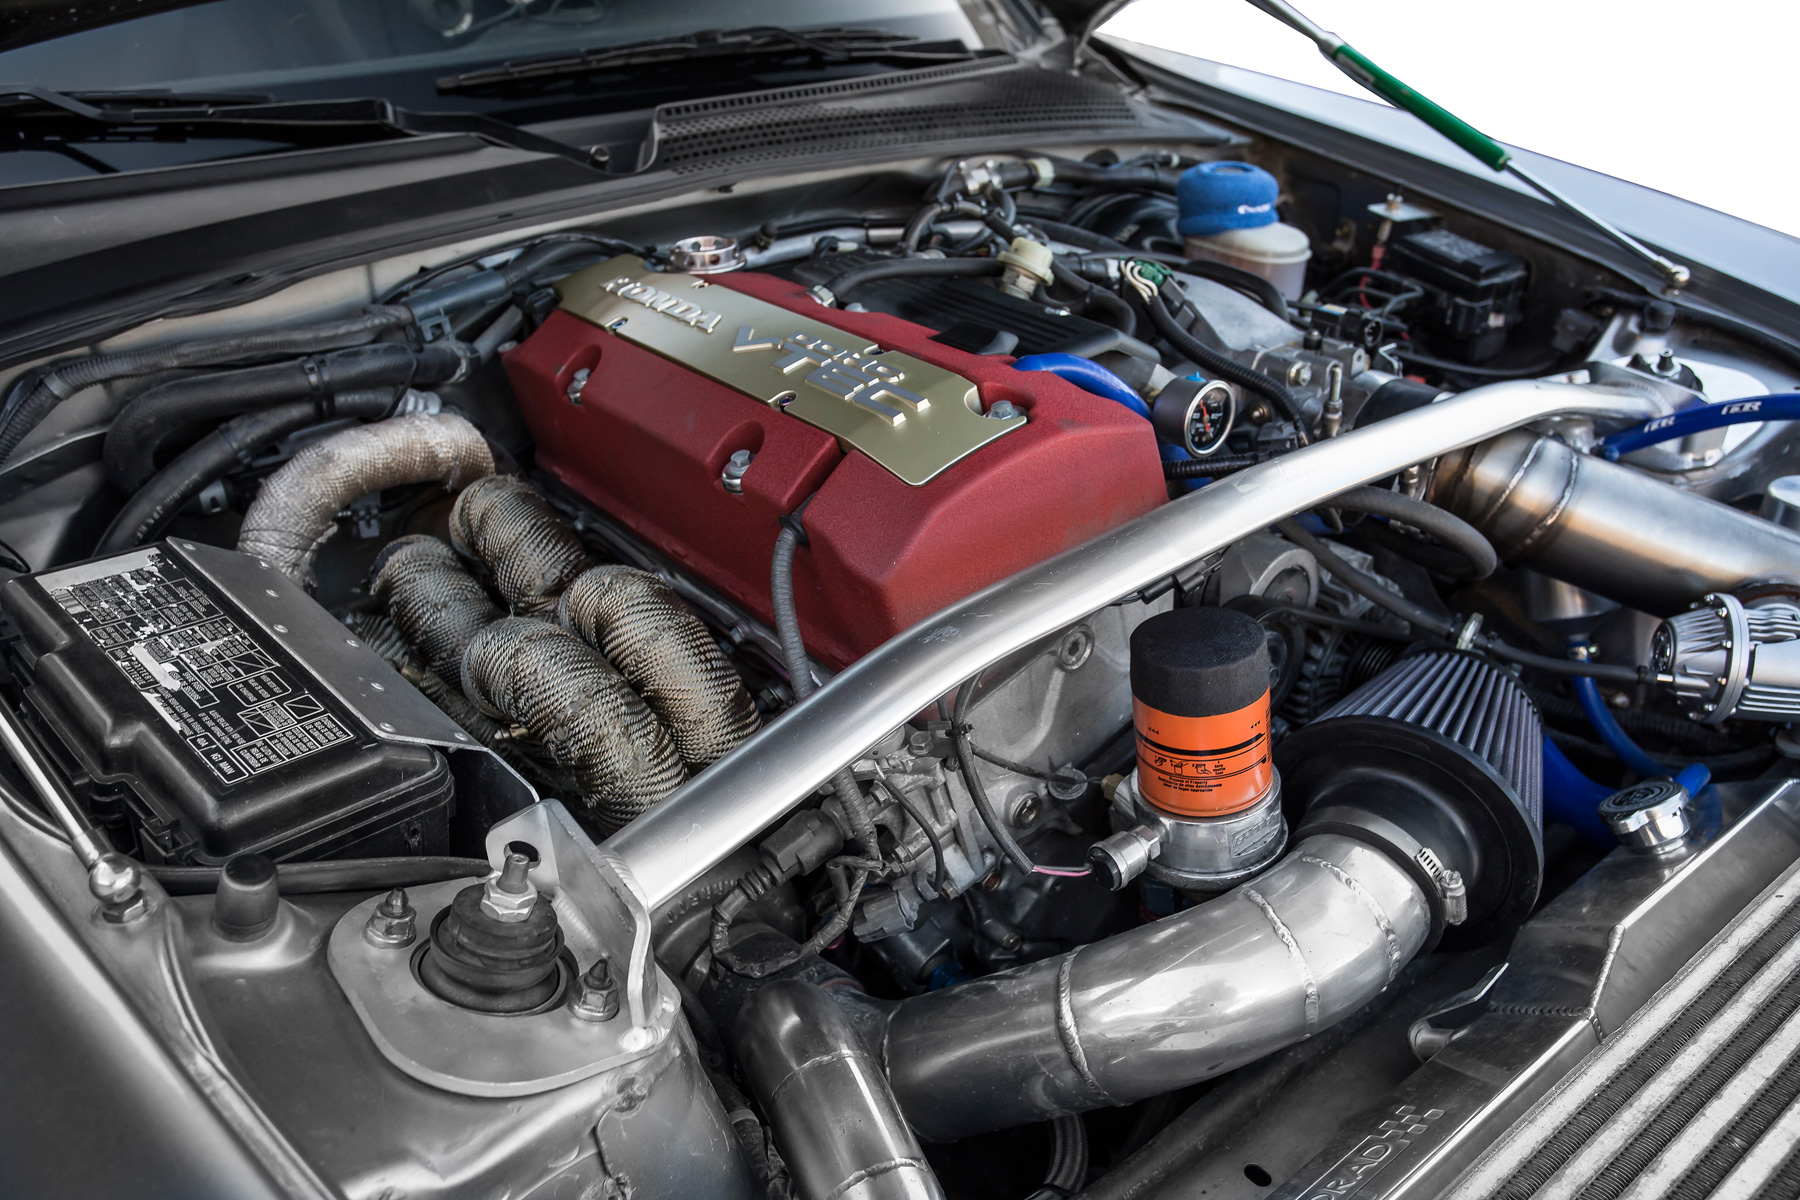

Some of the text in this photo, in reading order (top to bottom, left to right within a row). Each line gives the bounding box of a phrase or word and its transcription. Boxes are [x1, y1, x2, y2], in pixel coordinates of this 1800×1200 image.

[599, 277, 722, 333] HONDA
[732, 324, 931, 427] VTEC
[786, 331, 906, 383] DOHC
[131, 661, 154, 682] BATTERY
[219, 762, 235, 774] MAIN
